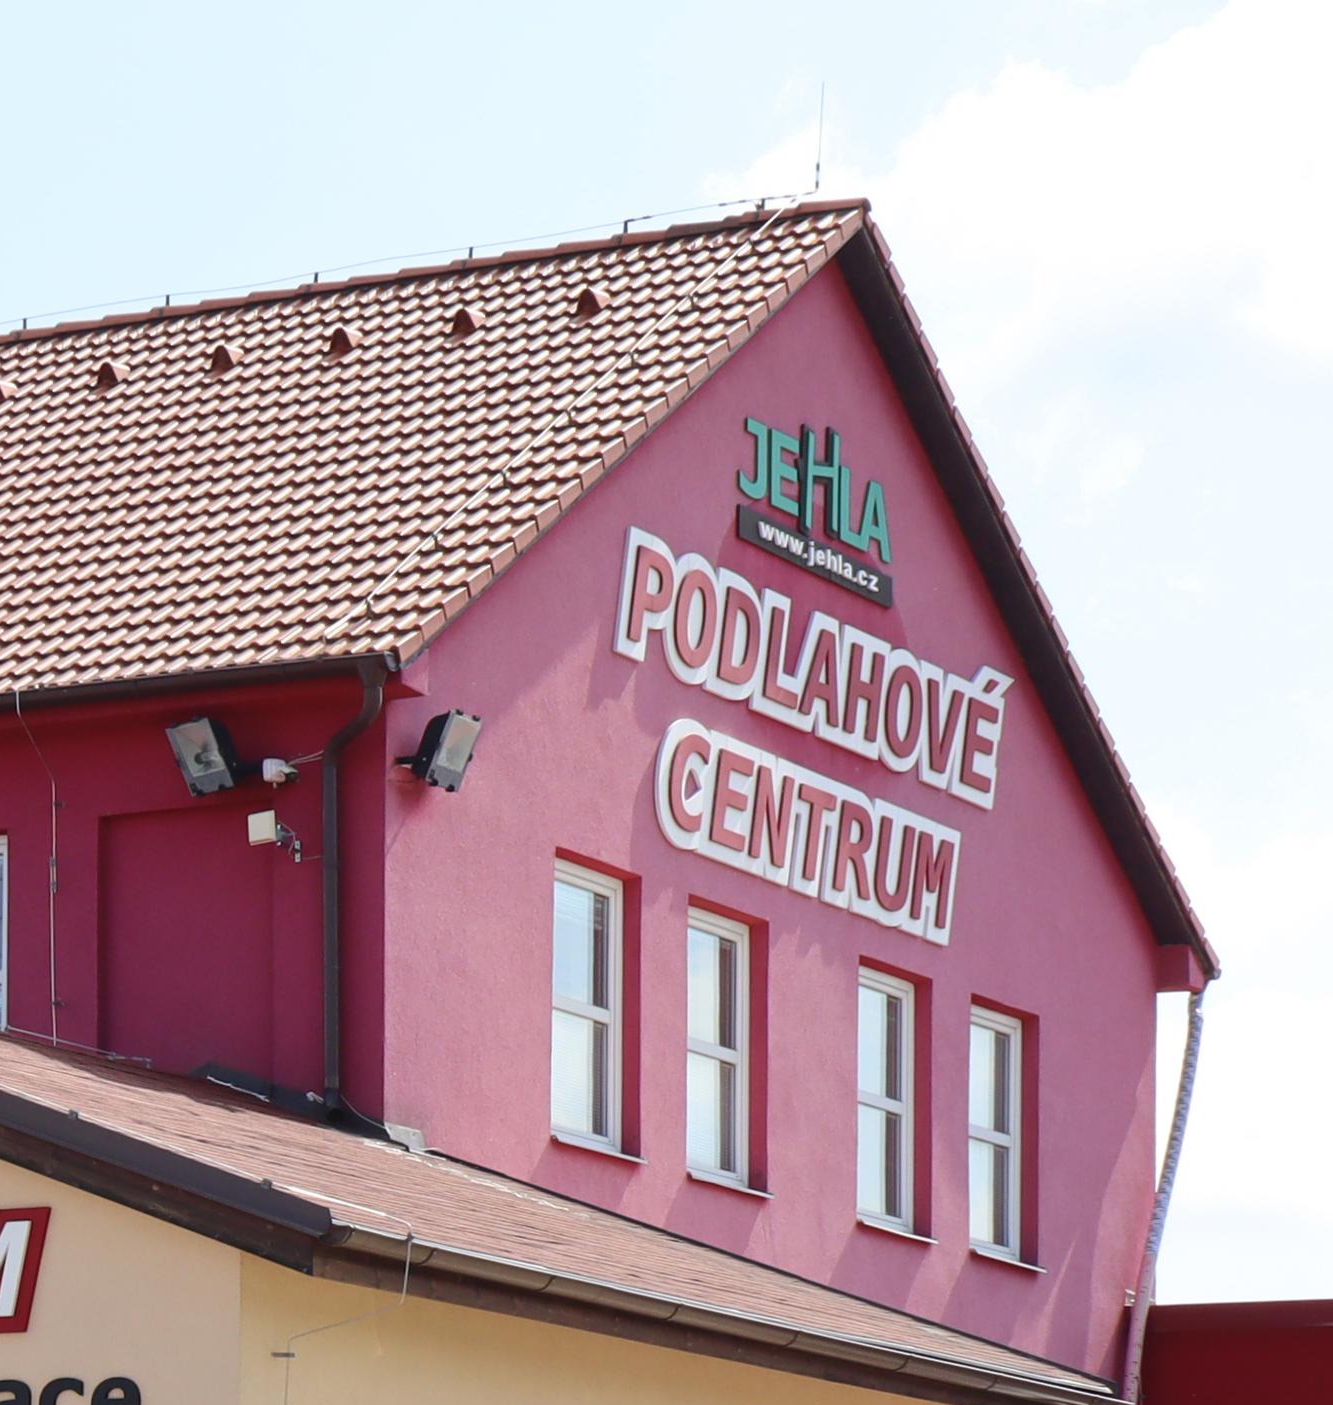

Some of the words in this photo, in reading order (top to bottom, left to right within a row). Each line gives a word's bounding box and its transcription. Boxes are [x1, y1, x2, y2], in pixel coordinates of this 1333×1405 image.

[738, 417, 892, 562] JEHLA
[758, 520, 880, 594] www.jehla.cz
[627, 545, 1001, 793] PODLAHOVÉ
[671, 733, 954, 930] CENTRUM
